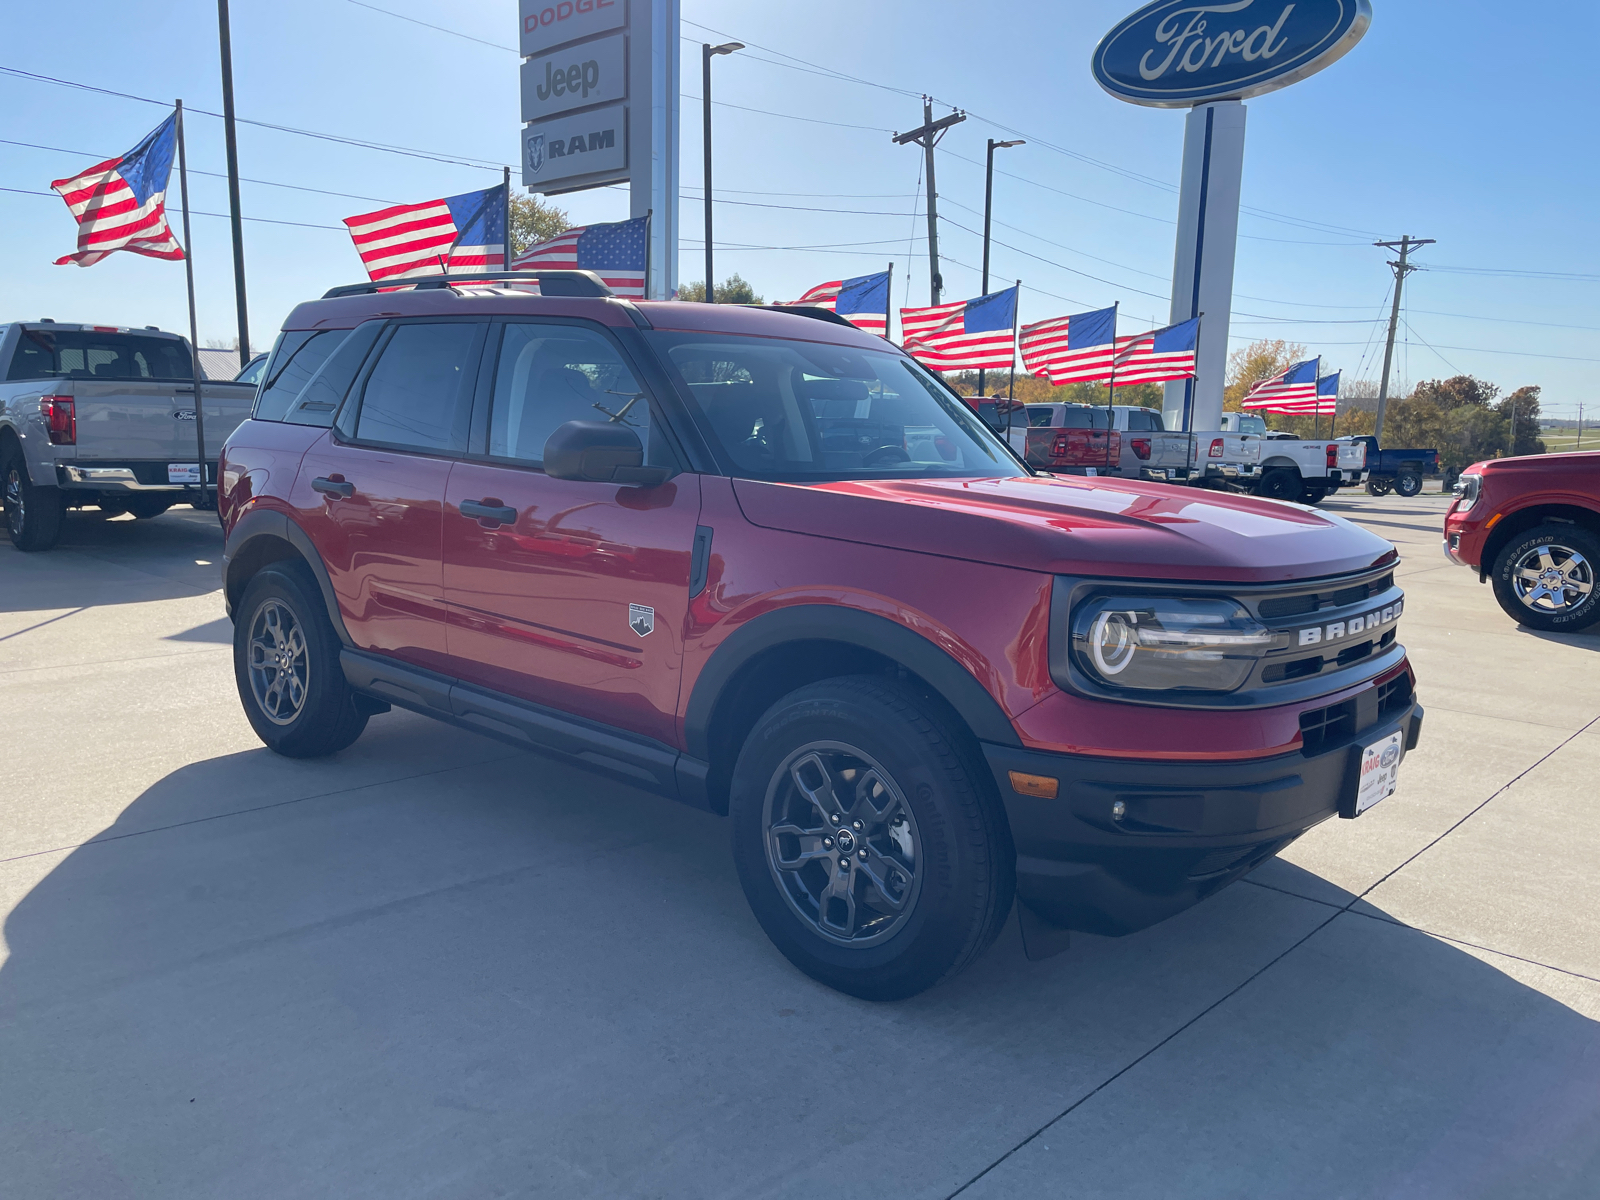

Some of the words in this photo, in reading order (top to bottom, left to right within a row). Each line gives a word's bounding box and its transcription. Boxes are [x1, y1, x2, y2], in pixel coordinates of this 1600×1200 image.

[1139, 0, 1296, 81] Ford
[536, 60, 599, 101] Jeep
[549, 129, 615, 160] RAM
[1298, 601, 1402, 646] BRONCO
